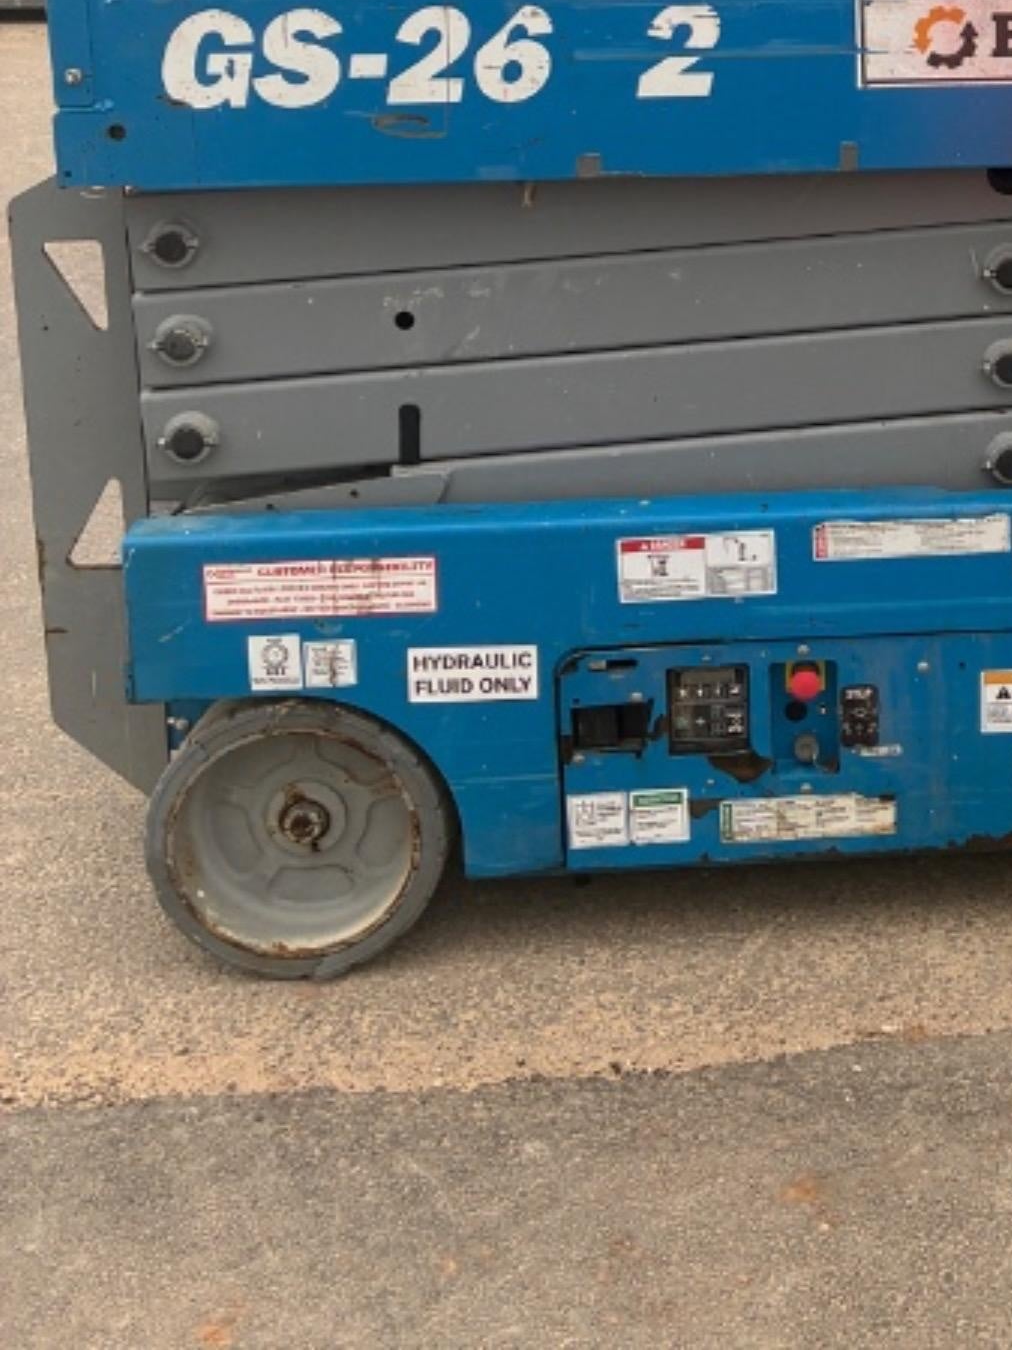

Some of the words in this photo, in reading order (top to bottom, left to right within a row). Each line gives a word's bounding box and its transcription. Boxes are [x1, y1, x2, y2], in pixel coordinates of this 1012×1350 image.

[413, 651, 532, 672] HYDRAULIC
[415, 678, 475, 696] FLUID
[480, 676, 531, 694] ONLY
